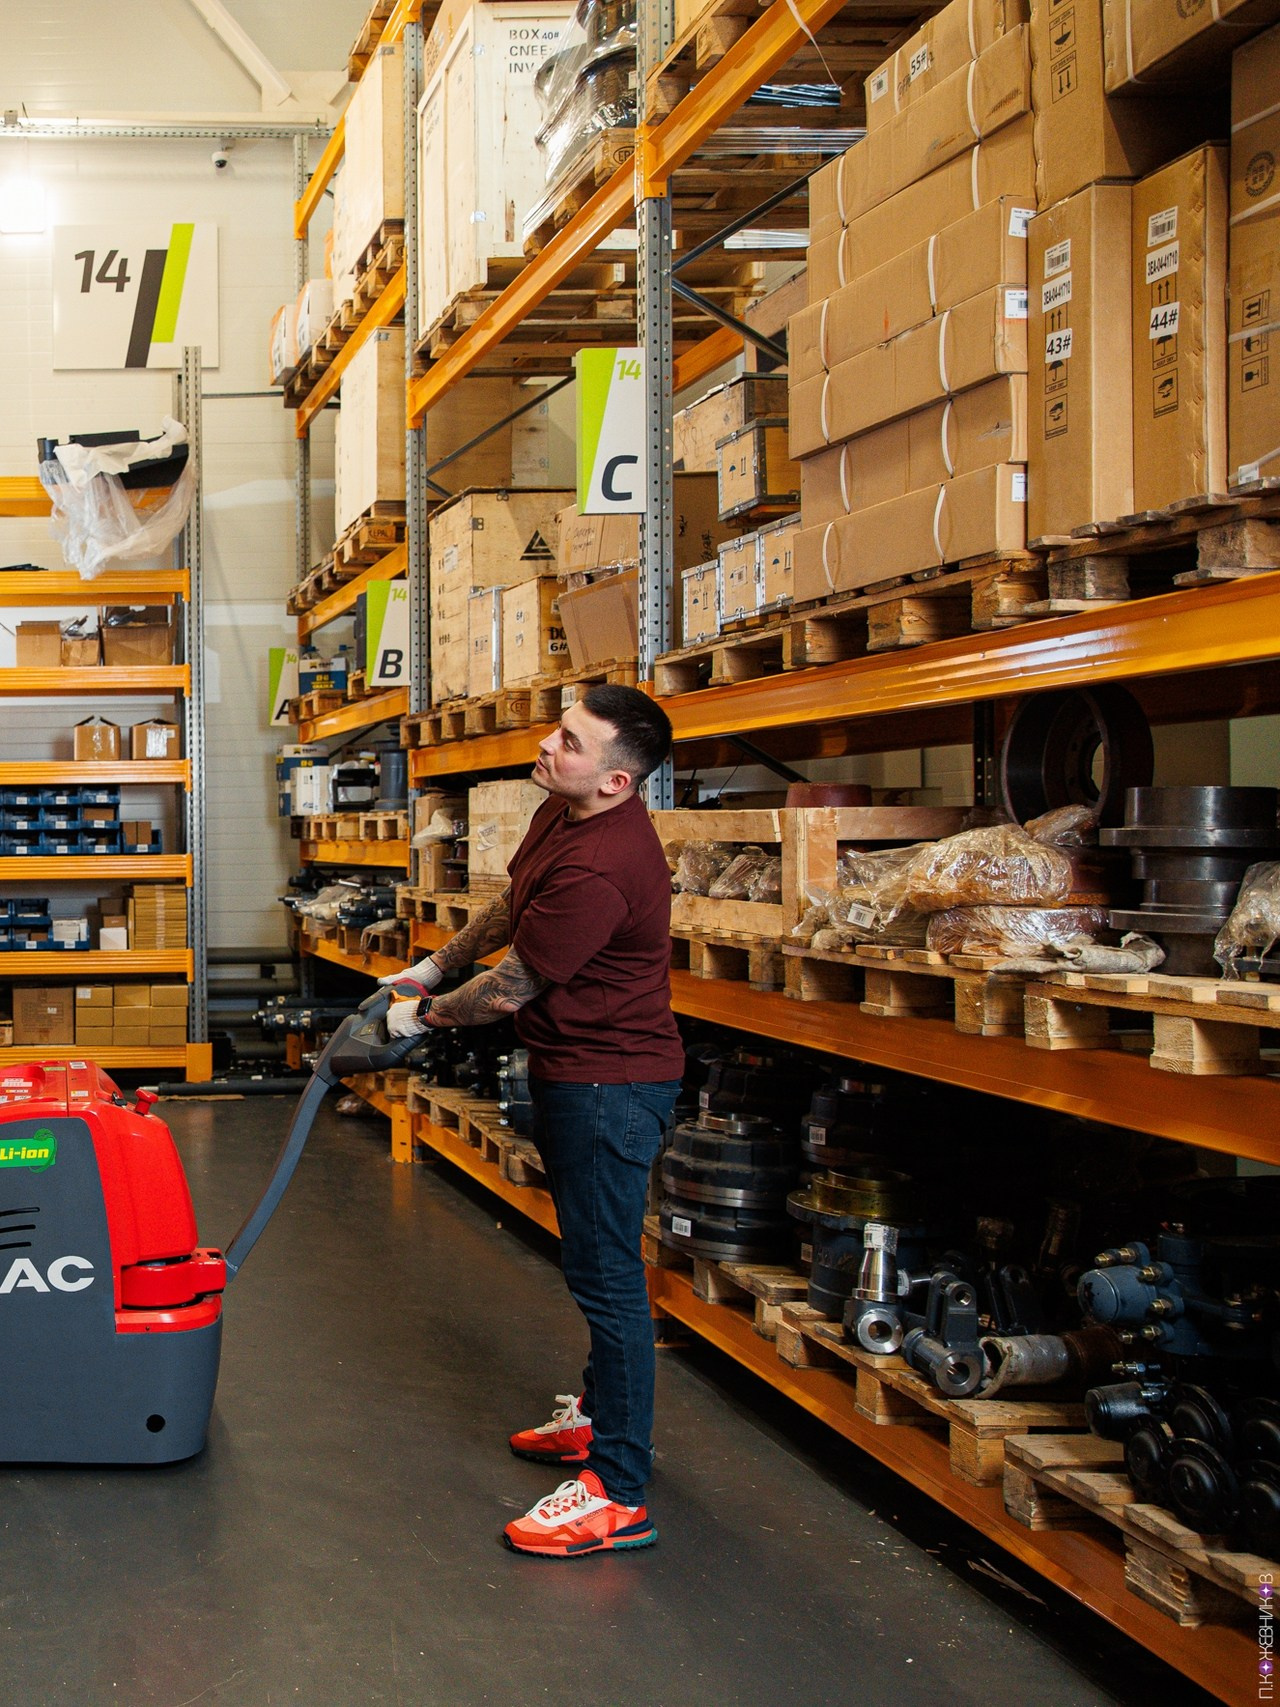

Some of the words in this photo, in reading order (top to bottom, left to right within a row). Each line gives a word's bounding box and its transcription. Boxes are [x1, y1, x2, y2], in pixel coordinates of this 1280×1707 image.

[509, 28, 540, 41] BOX
[541, 31, 560, 41] 40#
[911, 49, 927, 76] 55#
[73, 249, 131, 294] 14
[1150, 308, 1178, 331] 44#
[1046, 333, 1072, 356] 43#
[616, 359, 642, 382] 14
[600, 454, 638, 502] C
[391, 587, 408, 602] 14
[550, 642, 568, 652] 6#
[285, 653, 297, 665] 14
[378, 648, 404, 679] B
[0, 1147, 49, 1161] Li-ion
